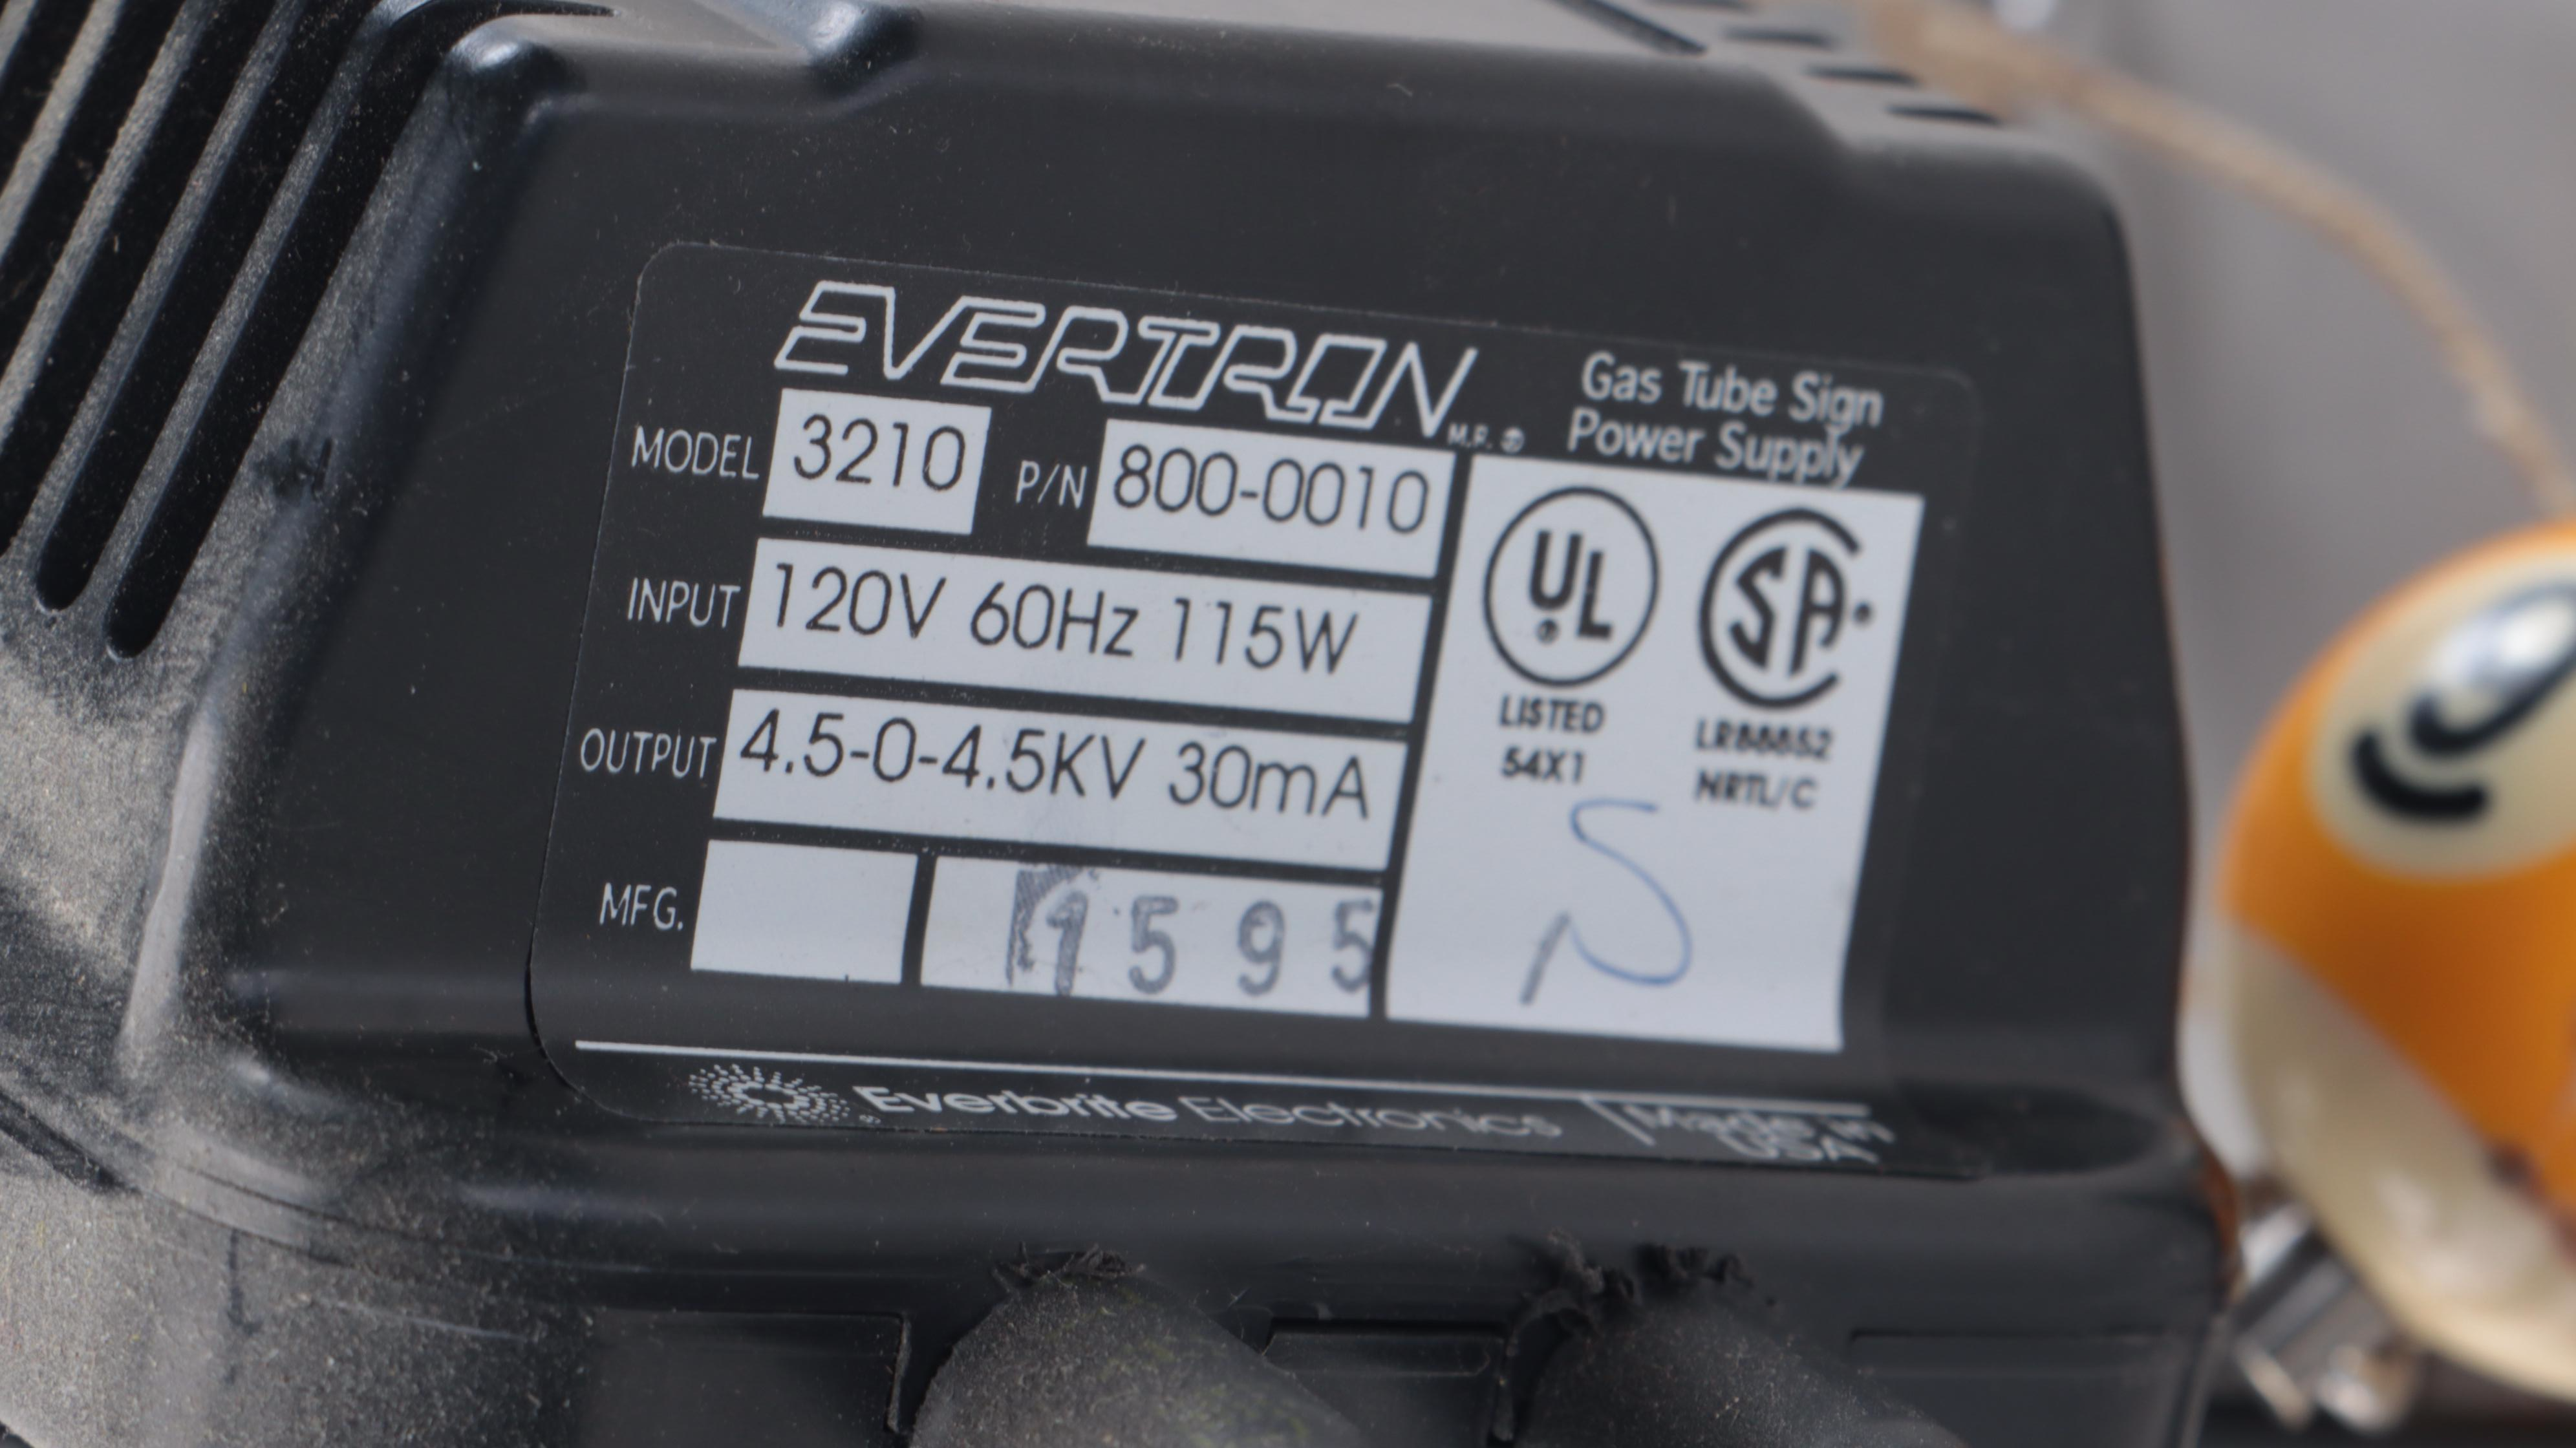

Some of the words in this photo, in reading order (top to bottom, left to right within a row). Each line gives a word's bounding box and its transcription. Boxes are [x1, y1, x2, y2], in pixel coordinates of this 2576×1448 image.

[774, 280, 1479, 437] EVERTRON
[1582, 350, 1662, 406] Gas
[1679, 359, 1778, 416] Tube
[1789, 370, 1884, 434] Sign
[631, 425, 760, 481] MODEL
[793, 413, 967, 492] 3210
[1015, 460, 1088, 509] P/N
[1113, 443, 1428, 534] 800-0010
[1567, 407, 1704, 463] Power
[1715, 421, 1864, 487] Supply
[627, 576, 742, 628] INPUT
[775, 562, 947, 639] 120V
[969, 581, 1141, 657] 60Hz
[1174, 597, 1359, 675] 115W
[1528, 529, 1613, 640] UL
[1497, 694, 1605, 735] LISTED
[579, 727, 718, 780] OUTPUT
[739, 708, 1146, 800] 4.5-0-4.5KV
[1168, 740, 1369, 820] 30mA
[1501, 746, 1586, 784] 54X1
[1693, 767, 1818, 812] NRTL/C
[599, 881, 685, 932] MFG.
[852, 1084, 1177, 1122] Everbrite
[1179, 1096, 1563, 1138] Electronics
